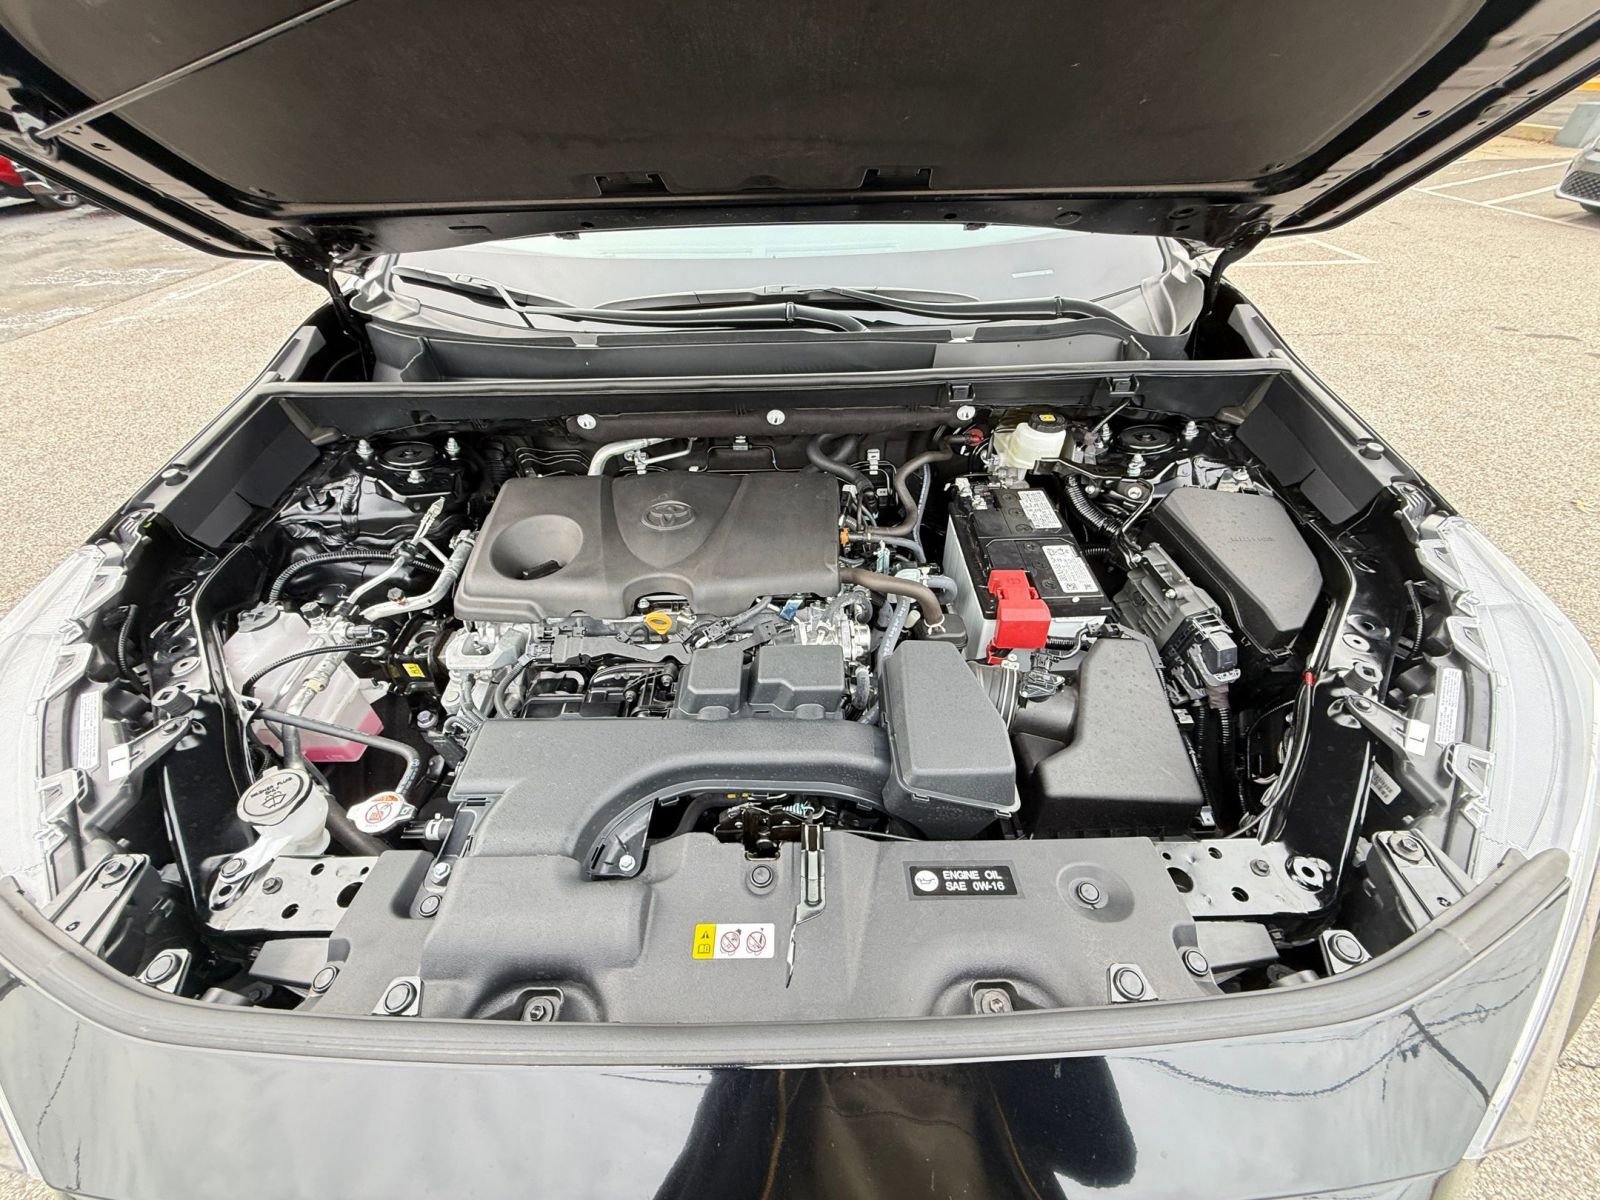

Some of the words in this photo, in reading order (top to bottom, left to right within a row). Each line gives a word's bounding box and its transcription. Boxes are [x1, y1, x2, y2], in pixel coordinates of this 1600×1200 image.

[942, 870, 981, 880] ENGINE
[984, 870, 1003, 880] OIL
[945, 881, 968, 891] SAE
[972, 881, 1006, 891] 0W-16
